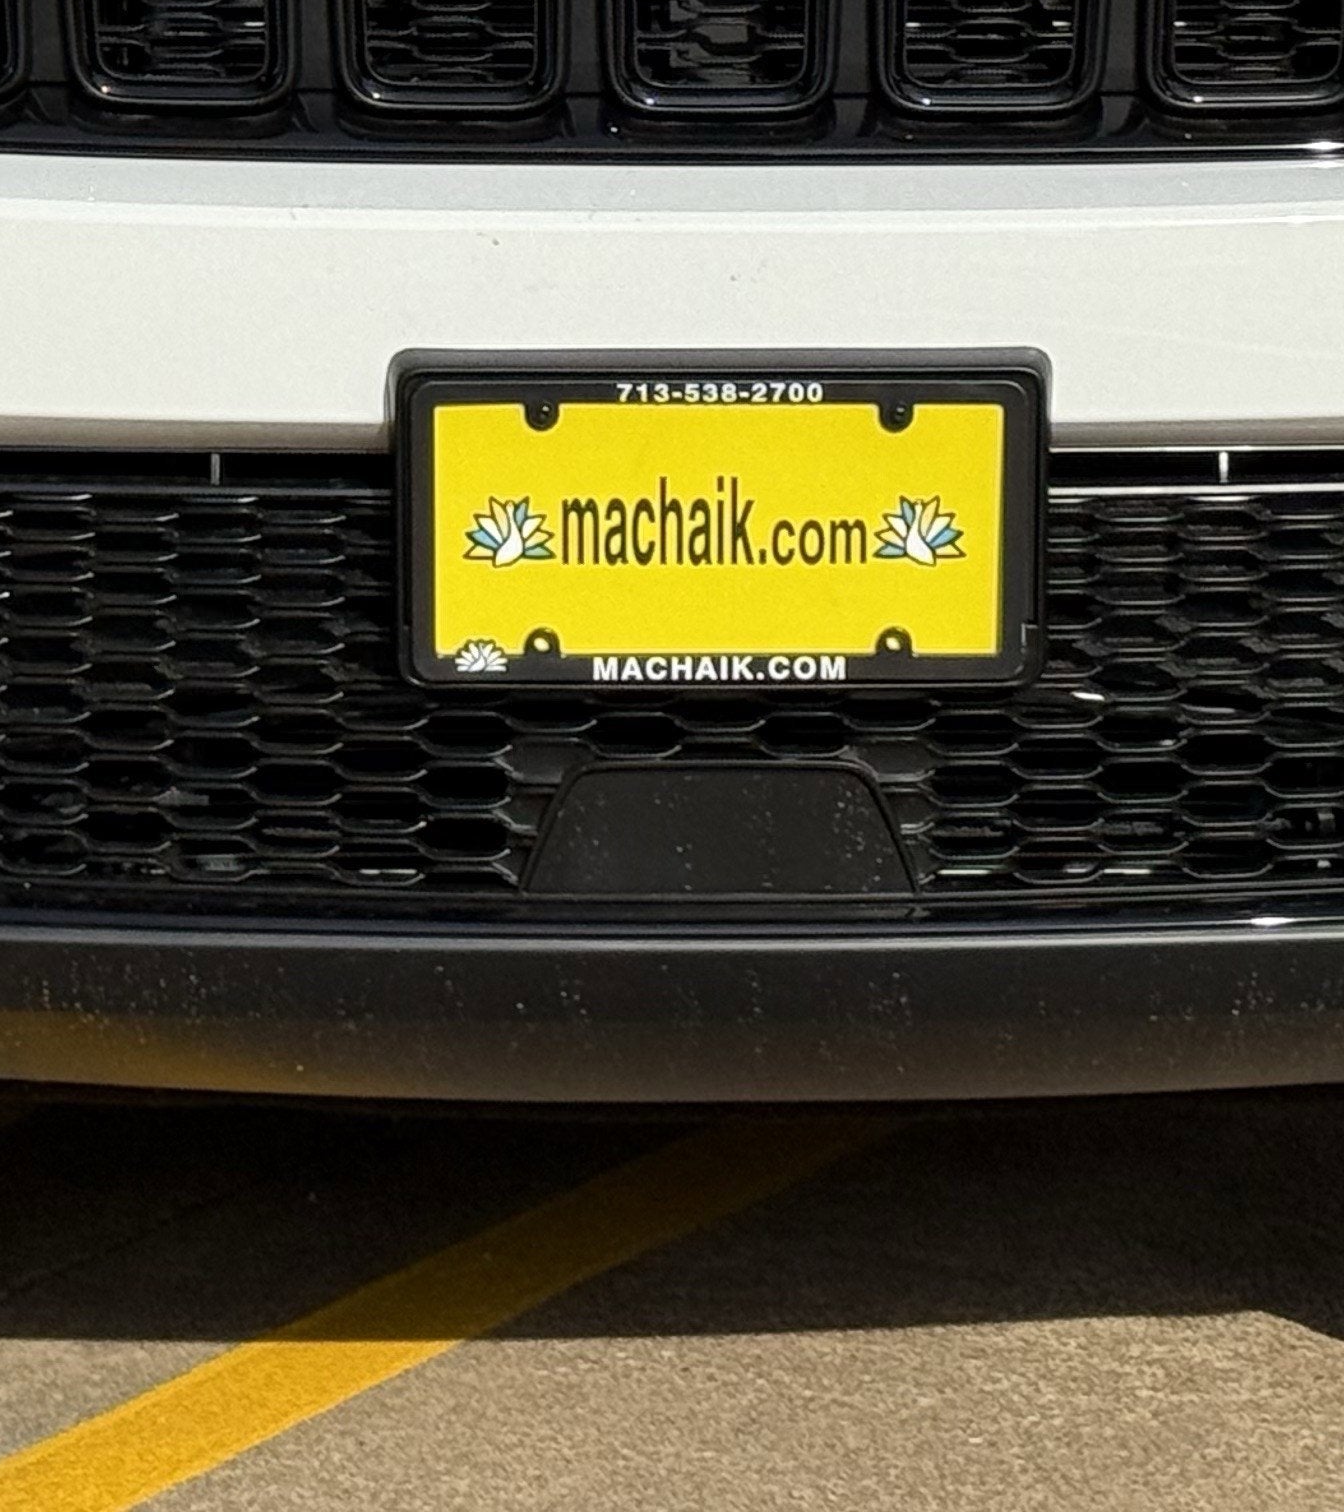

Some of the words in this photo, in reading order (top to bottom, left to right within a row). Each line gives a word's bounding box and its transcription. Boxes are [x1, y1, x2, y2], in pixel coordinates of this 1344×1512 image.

[615, 383, 824, 403] 713-538-2700
[560, 476, 868, 566] machaik.com
[592, 656, 847, 681] MACHAIK.COM
